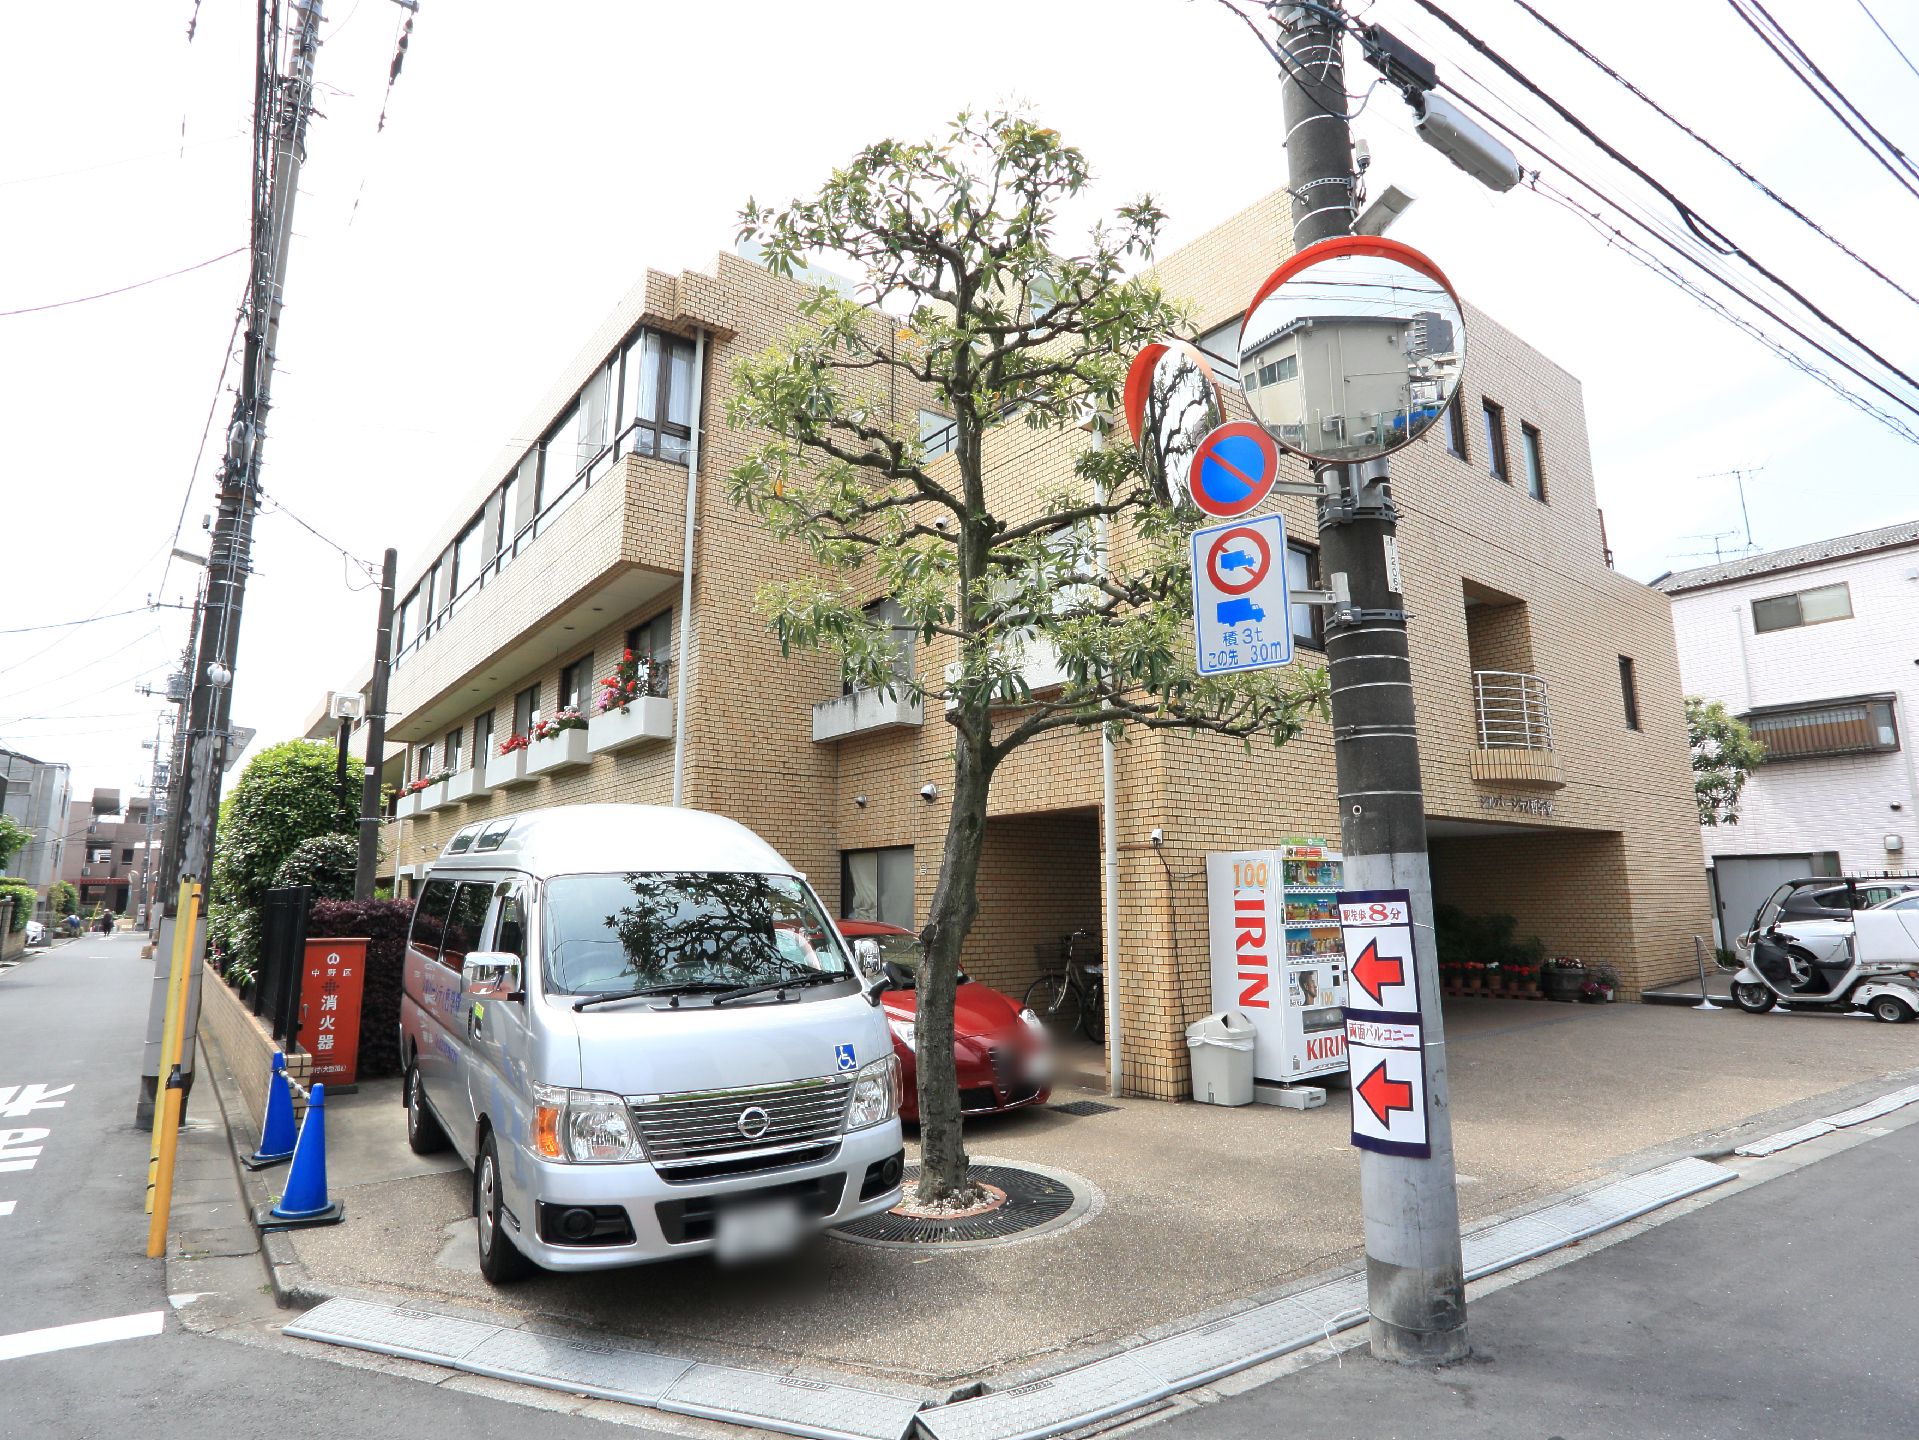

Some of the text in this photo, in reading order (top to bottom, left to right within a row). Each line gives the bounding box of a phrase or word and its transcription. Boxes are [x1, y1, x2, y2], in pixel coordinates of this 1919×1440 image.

[1208, 641, 1282, 668] この先 30m
[1234, 863, 1268, 887] 100
[1343, 903, 1401, 921] 駅徒歩8分
[1234, 890, 1270, 1008] IRIN
[311, 968, 352, 978] 中野区
[317, 994, 338, 1050] 消火器
